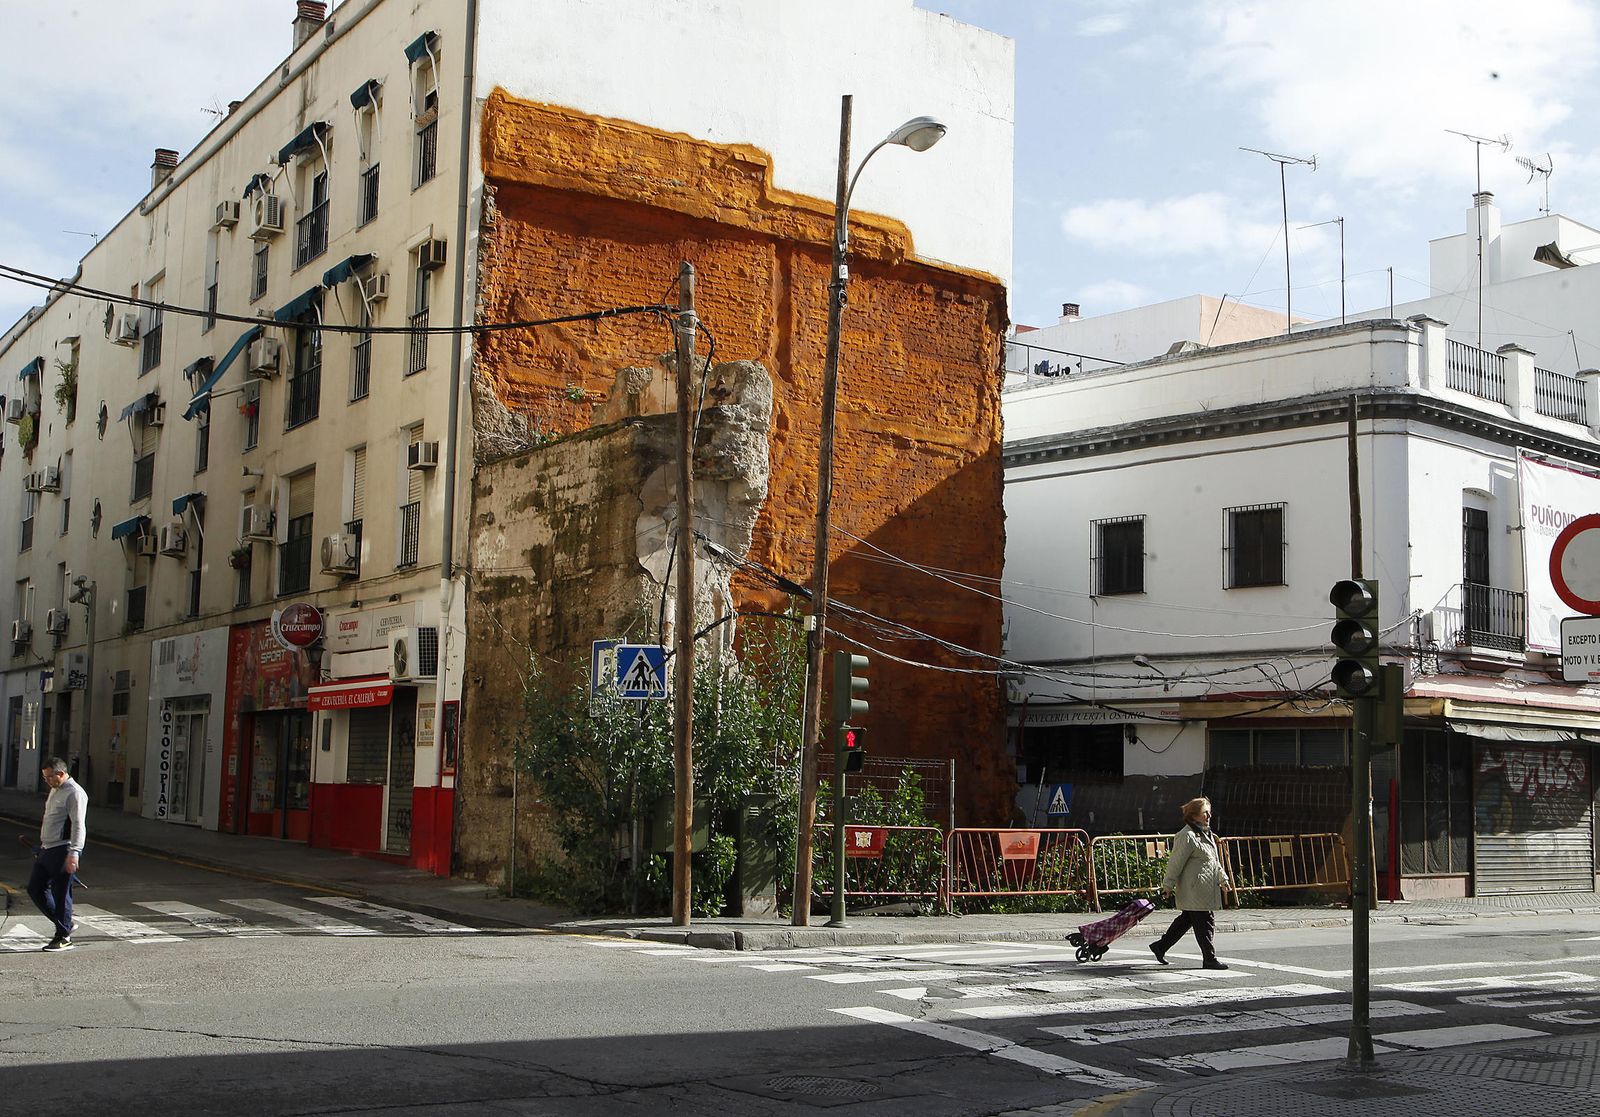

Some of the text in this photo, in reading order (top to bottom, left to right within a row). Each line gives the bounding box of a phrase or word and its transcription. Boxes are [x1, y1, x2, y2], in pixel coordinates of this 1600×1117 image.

[281, 623, 320, 632] Cruzcampo
[1568, 634, 1597, 646] EXCEPTO
[260, 649, 288, 664] SPORT
[1564, 656, 1582, 666] MOTO
[1583, 655, 1589, 665] Y
[1072, 711, 1107, 721] PUERTA
[158, 700, 172, 817] FOTOCOPIAS
